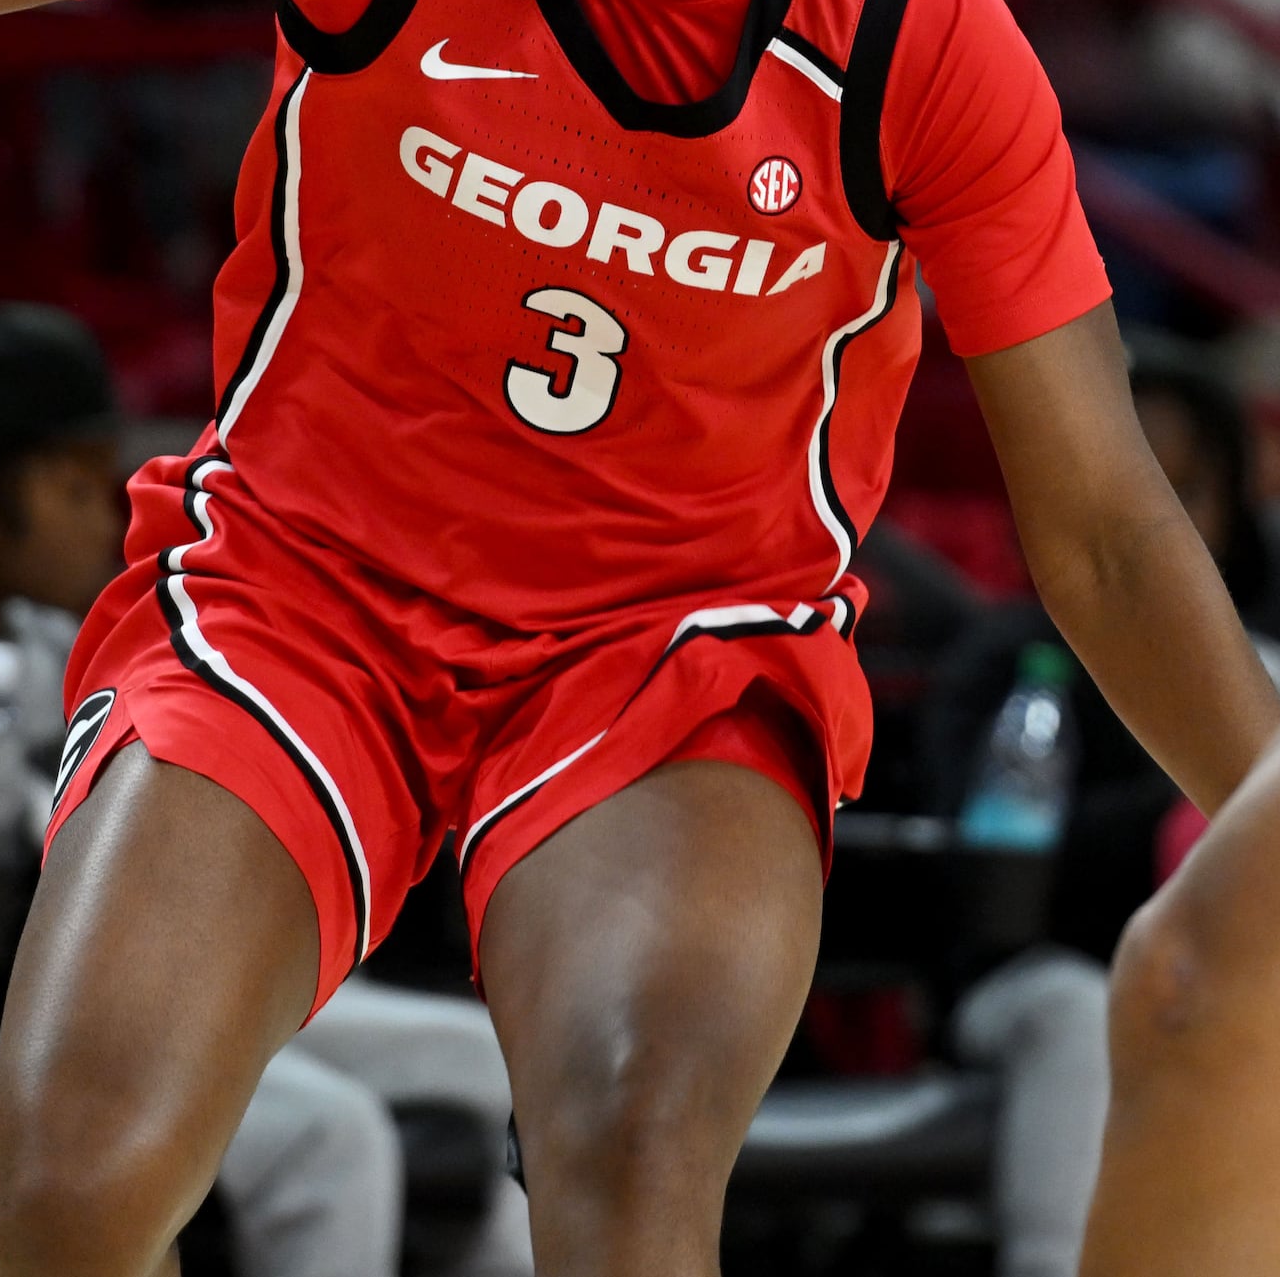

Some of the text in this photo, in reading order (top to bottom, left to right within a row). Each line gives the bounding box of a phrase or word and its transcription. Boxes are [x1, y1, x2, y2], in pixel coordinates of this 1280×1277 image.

[398, 125, 828, 298] GEORGIA
[752, 160, 798, 211] SEC
[502, 286, 628, 436] 3
